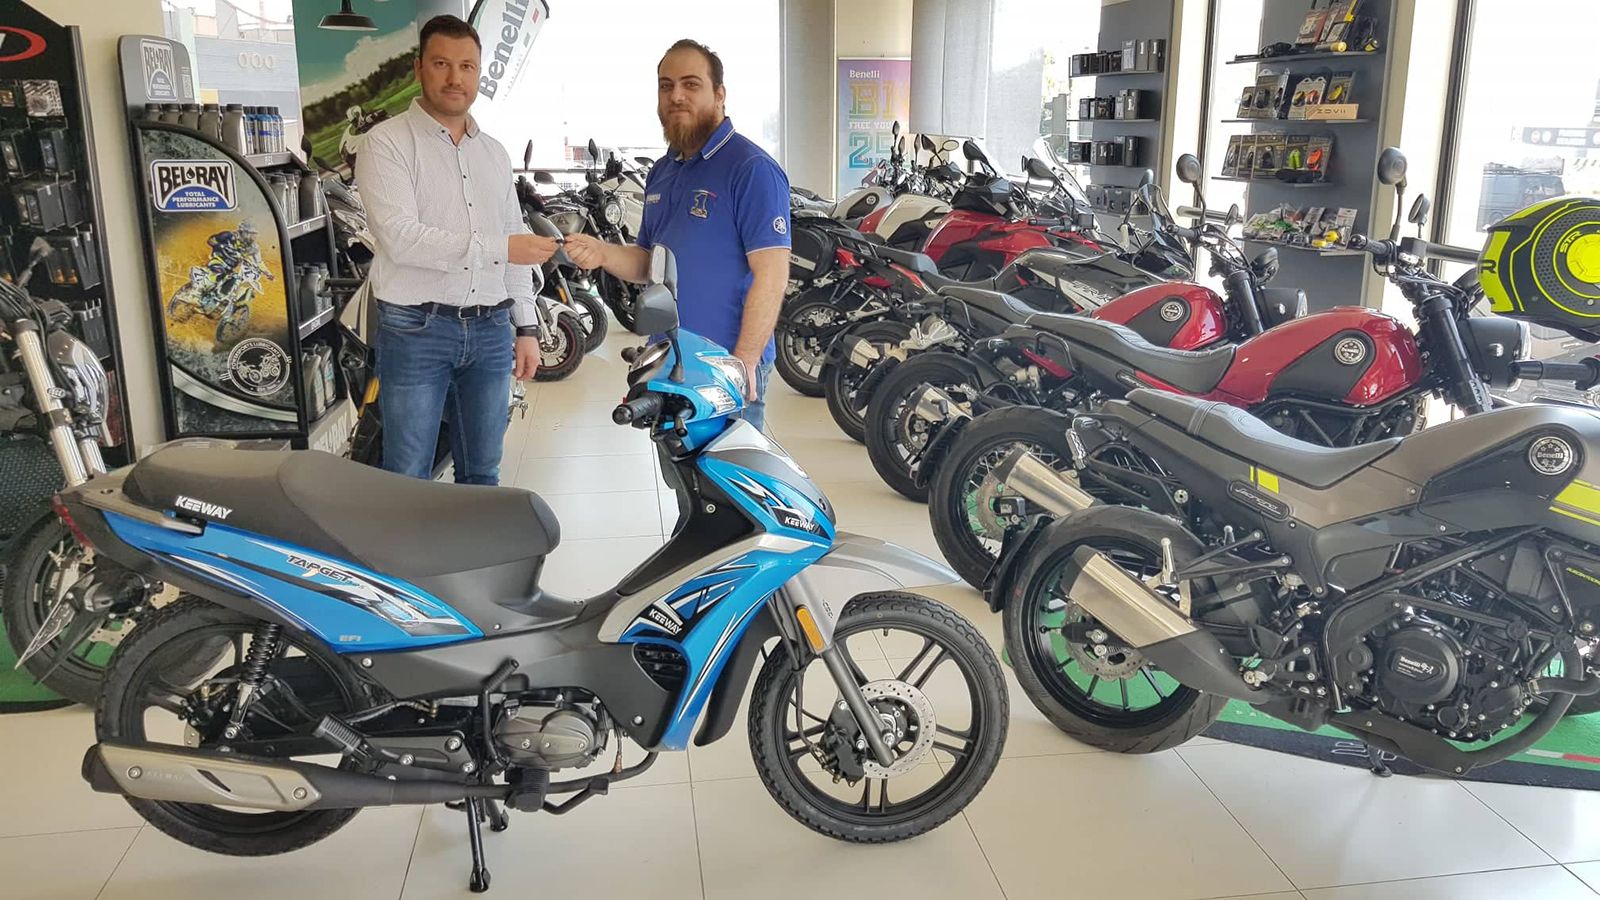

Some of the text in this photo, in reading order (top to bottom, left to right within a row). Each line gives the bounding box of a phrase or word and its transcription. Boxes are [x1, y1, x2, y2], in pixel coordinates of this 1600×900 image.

[849, 69, 880, 79] Benelli
[175, 495, 233, 520] KEEWAY
[784, 516, 815, 532] KEEWAY
[287, 555, 352, 582] TARGET
[649, 608, 682, 634] KEEWAY
